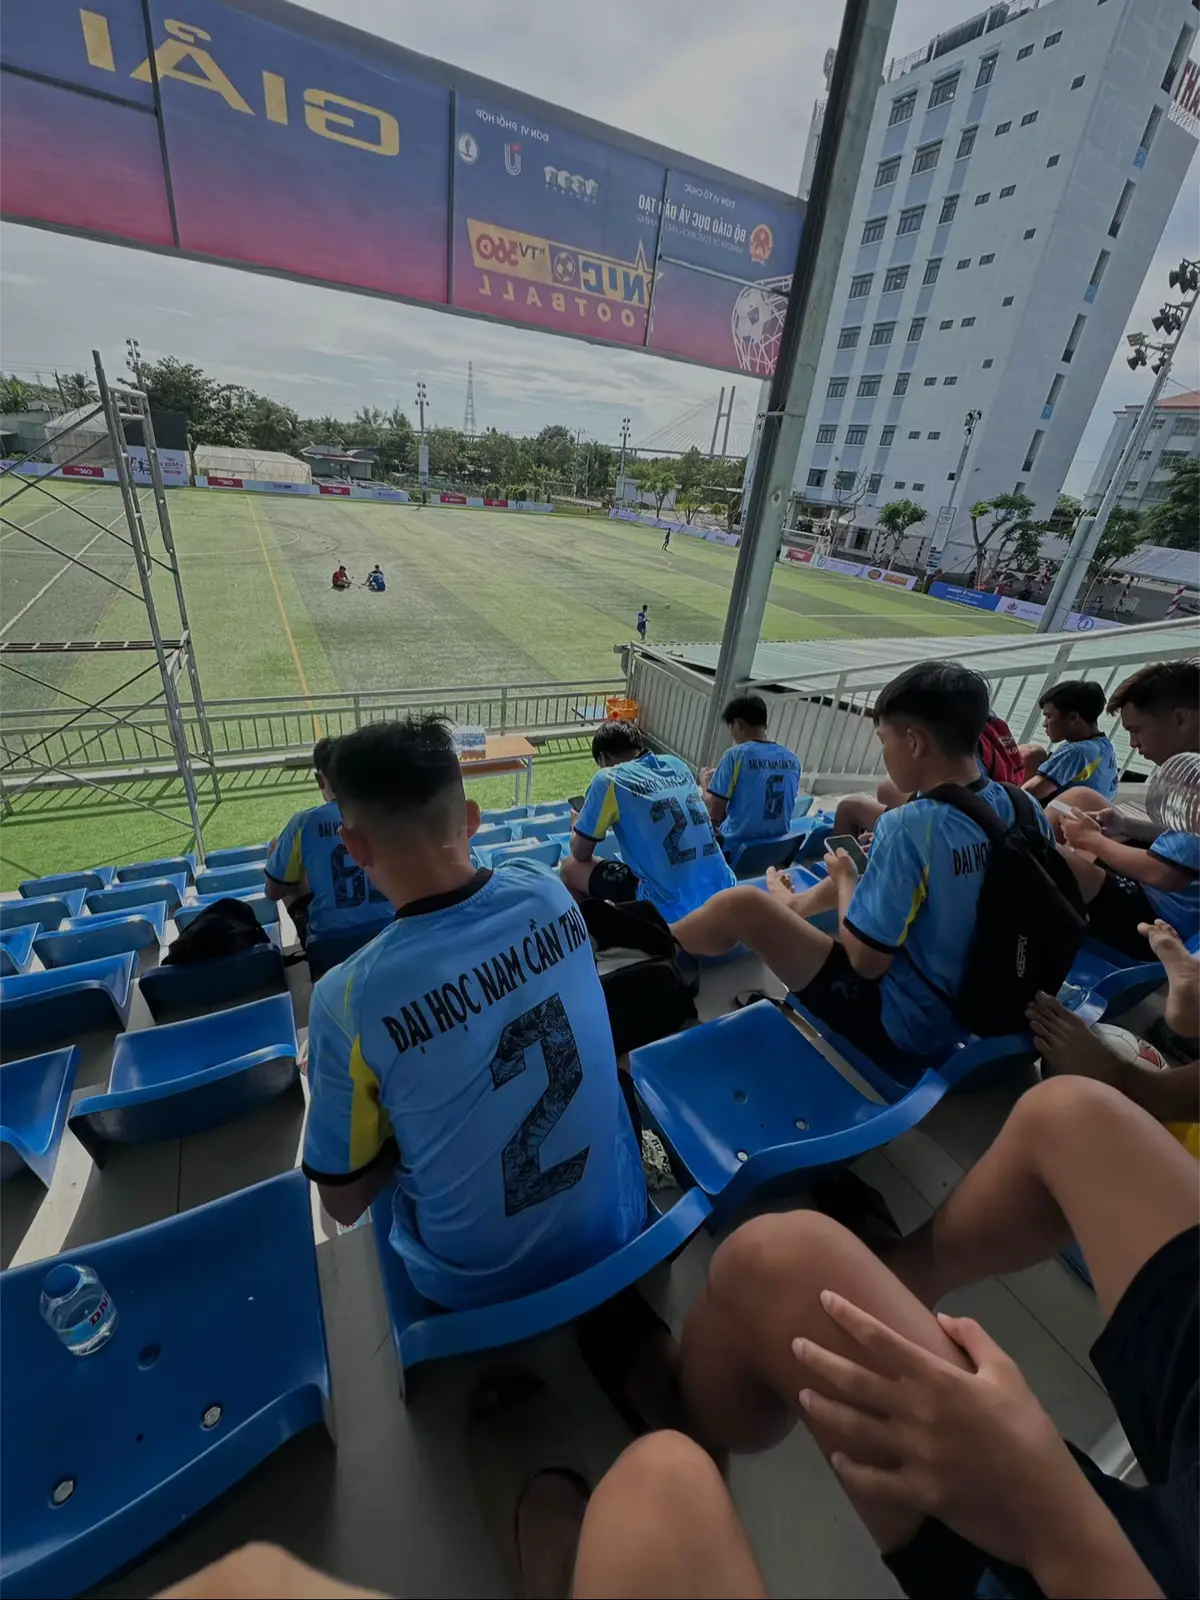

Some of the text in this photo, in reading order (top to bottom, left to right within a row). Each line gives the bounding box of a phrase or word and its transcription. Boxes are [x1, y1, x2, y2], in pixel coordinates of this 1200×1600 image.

[763, 774, 785, 820] 6
[381, 1000, 435, 1054] ĐẠI
[423, 973, 484, 1033] HỌC
[472, 945, 528, 1006] NAM
[523, 918, 565, 975] CẦN
[488, 992, 591, 1218] 2
